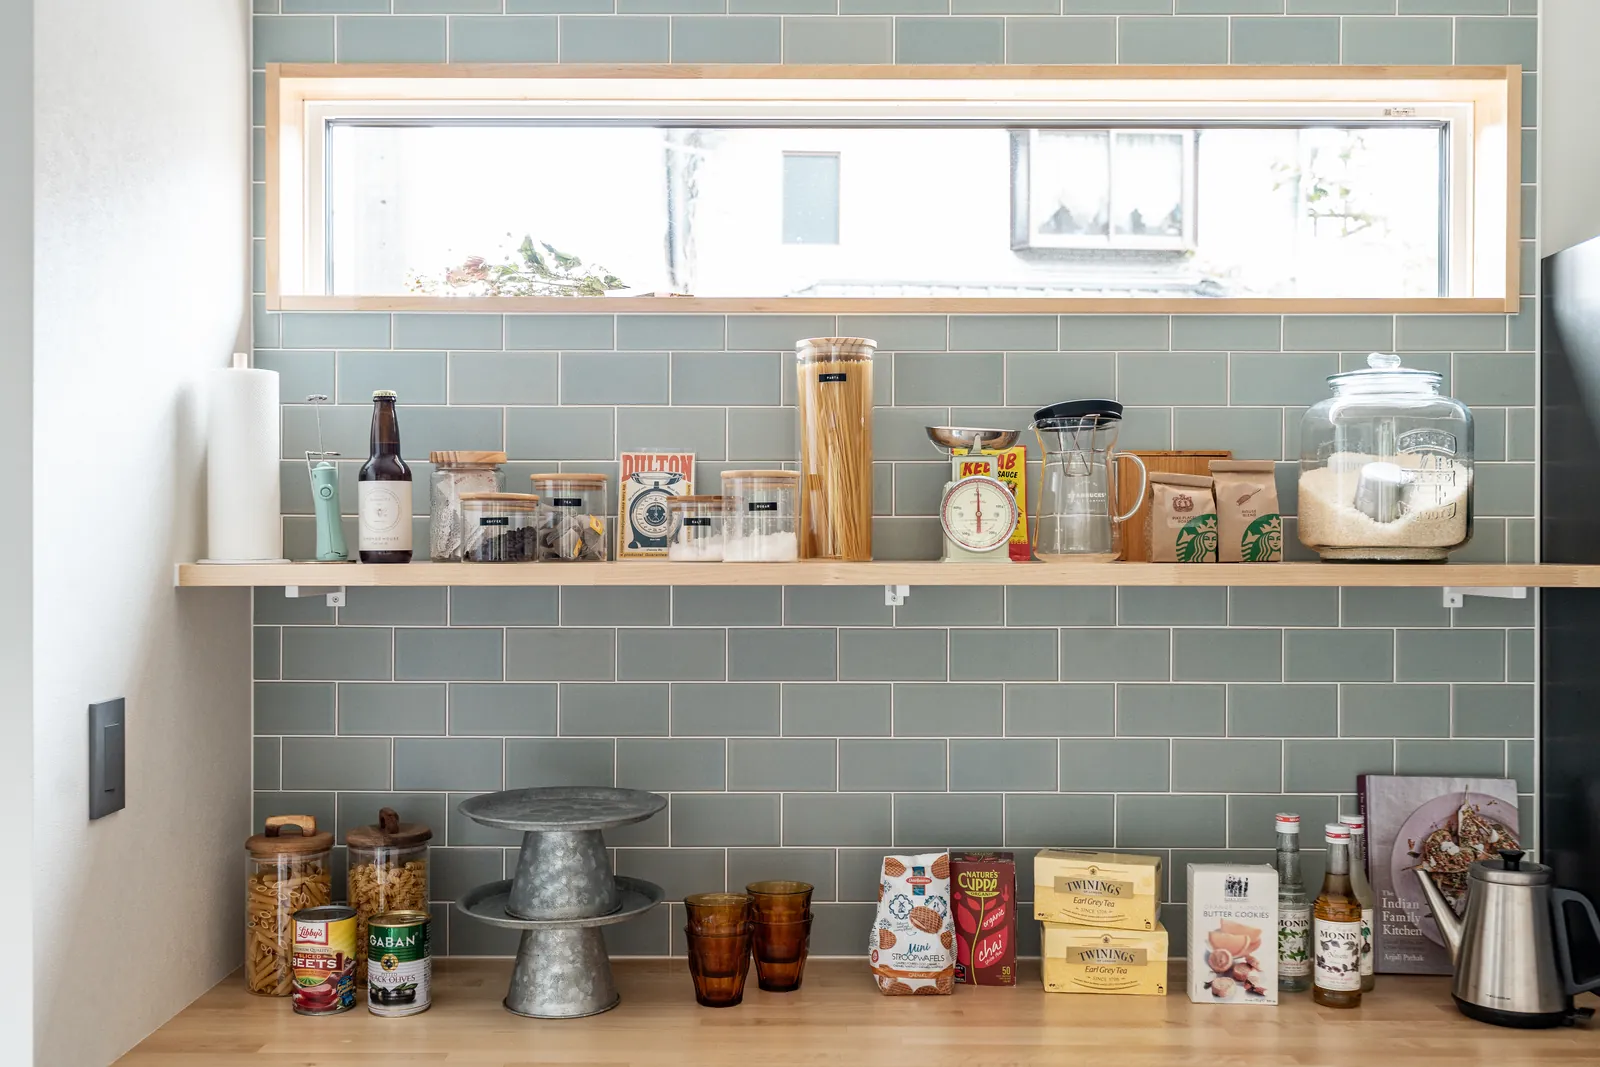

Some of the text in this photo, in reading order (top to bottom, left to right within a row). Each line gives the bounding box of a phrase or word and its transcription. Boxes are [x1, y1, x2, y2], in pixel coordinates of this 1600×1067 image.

[621, 454, 694, 483] DULTON
[997, 470, 1018, 479] SAUCE
[966, 869, 999, 879] NATURE'S
[957, 872, 998, 892] CUPPA
[1065, 880, 1121, 896] TWININGS
[1073, 896, 1115, 908] Earl Grey Tea
[1381, 897, 1419, 909] Indian
[983, 908, 1005, 927] organic
[1203, 910, 1233, 918] BUTTER
[1234, 911, 1270, 919] COOKIES
[1381, 910, 1421, 926] Family
[298, 925, 323, 939] Libby's
[1320, 930, 1357, 940] MONIN
[1382, 924, 1422, 936] Kitchen
[369, 934, 415, 948] GABAN
[906, 943, 931, 955] Mini
[978, 934, 1003, 962] chai
[891, 952, 945, 962] STROOPWAFELS
[1078, 948, 1135, 964] TWININGS
[292, 957, 337, 969] BEETS
[1001, 966, 1011, 975] 50
[1085, 965, 1099, 973] Earl
[1099, 966, 1116, 975] Grey
[388, 974, 416, 984] OLIVES
